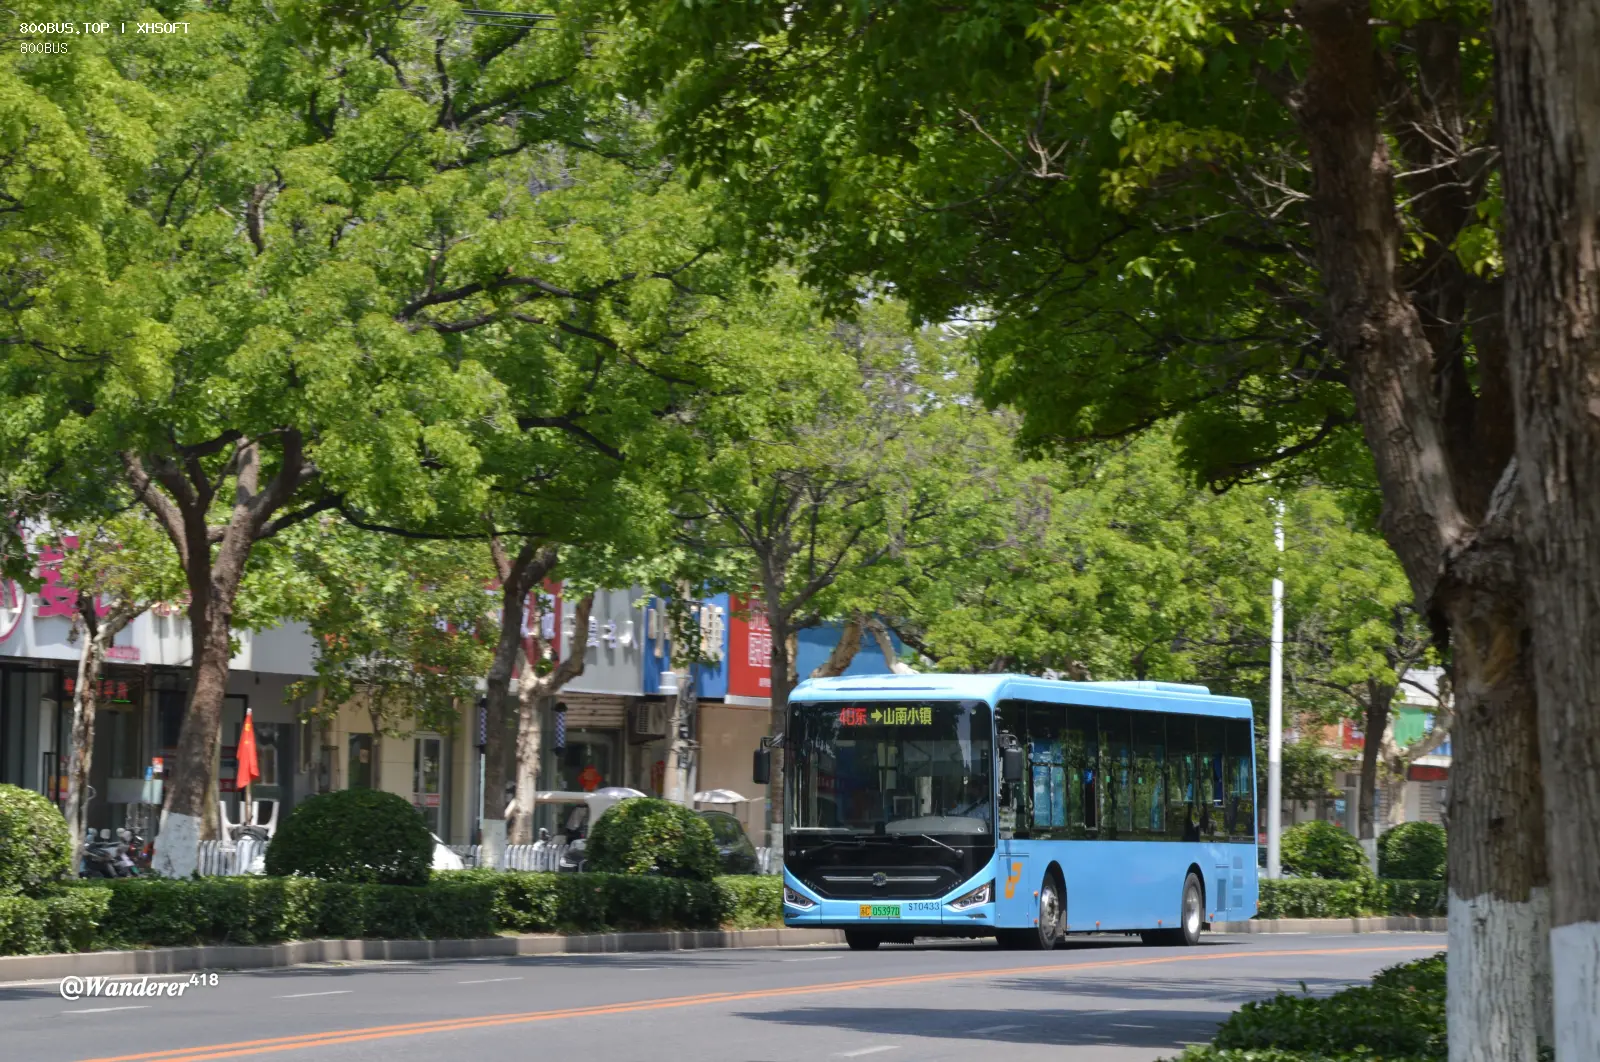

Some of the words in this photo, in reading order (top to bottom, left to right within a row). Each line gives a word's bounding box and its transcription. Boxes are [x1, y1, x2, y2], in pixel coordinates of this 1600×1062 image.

[883, 707, 932, 725] 山南小镇
[908, 902, 940, 911] ST0433
